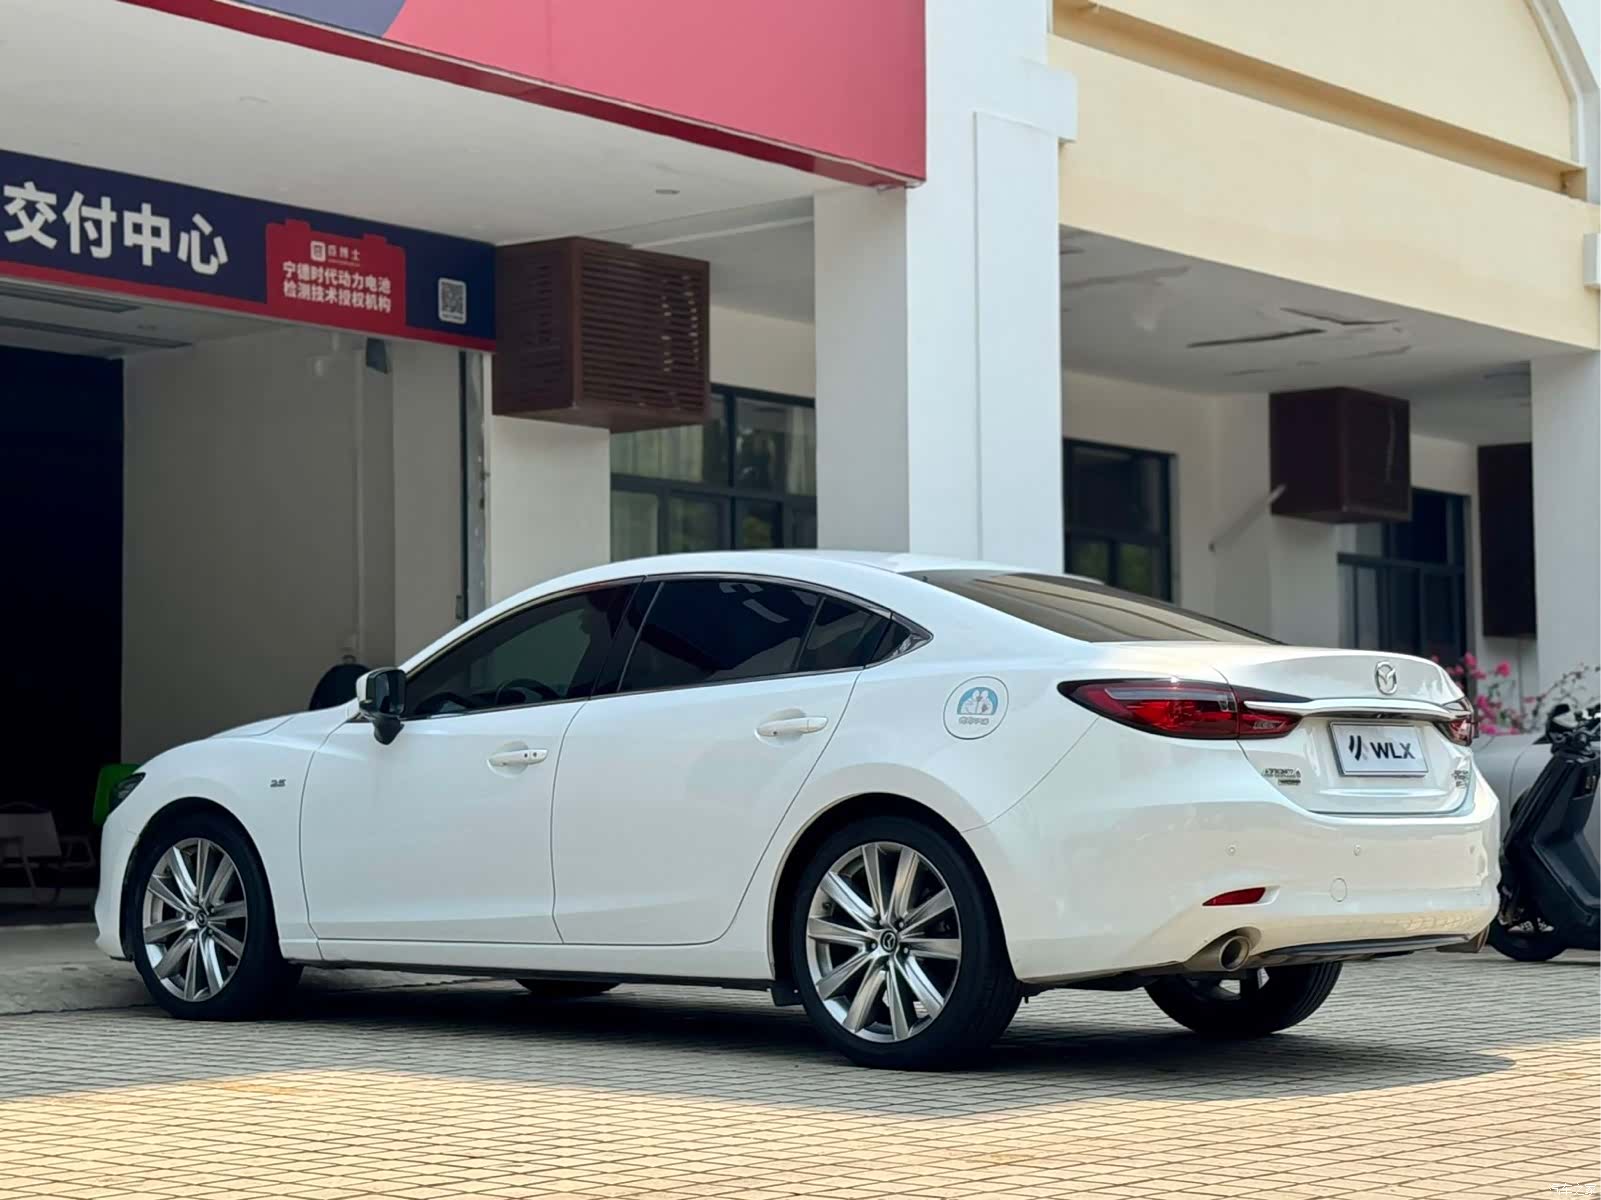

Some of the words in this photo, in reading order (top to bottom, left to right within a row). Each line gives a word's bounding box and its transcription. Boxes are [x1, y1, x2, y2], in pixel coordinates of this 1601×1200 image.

[3, 181, 228, 275] 交付中心
[282, 261, 391, 294] 宁德时代动力电池
[283, 280, 392, 313] 检测技术授权机构
[1370, 742, 1415, 759] WLX
